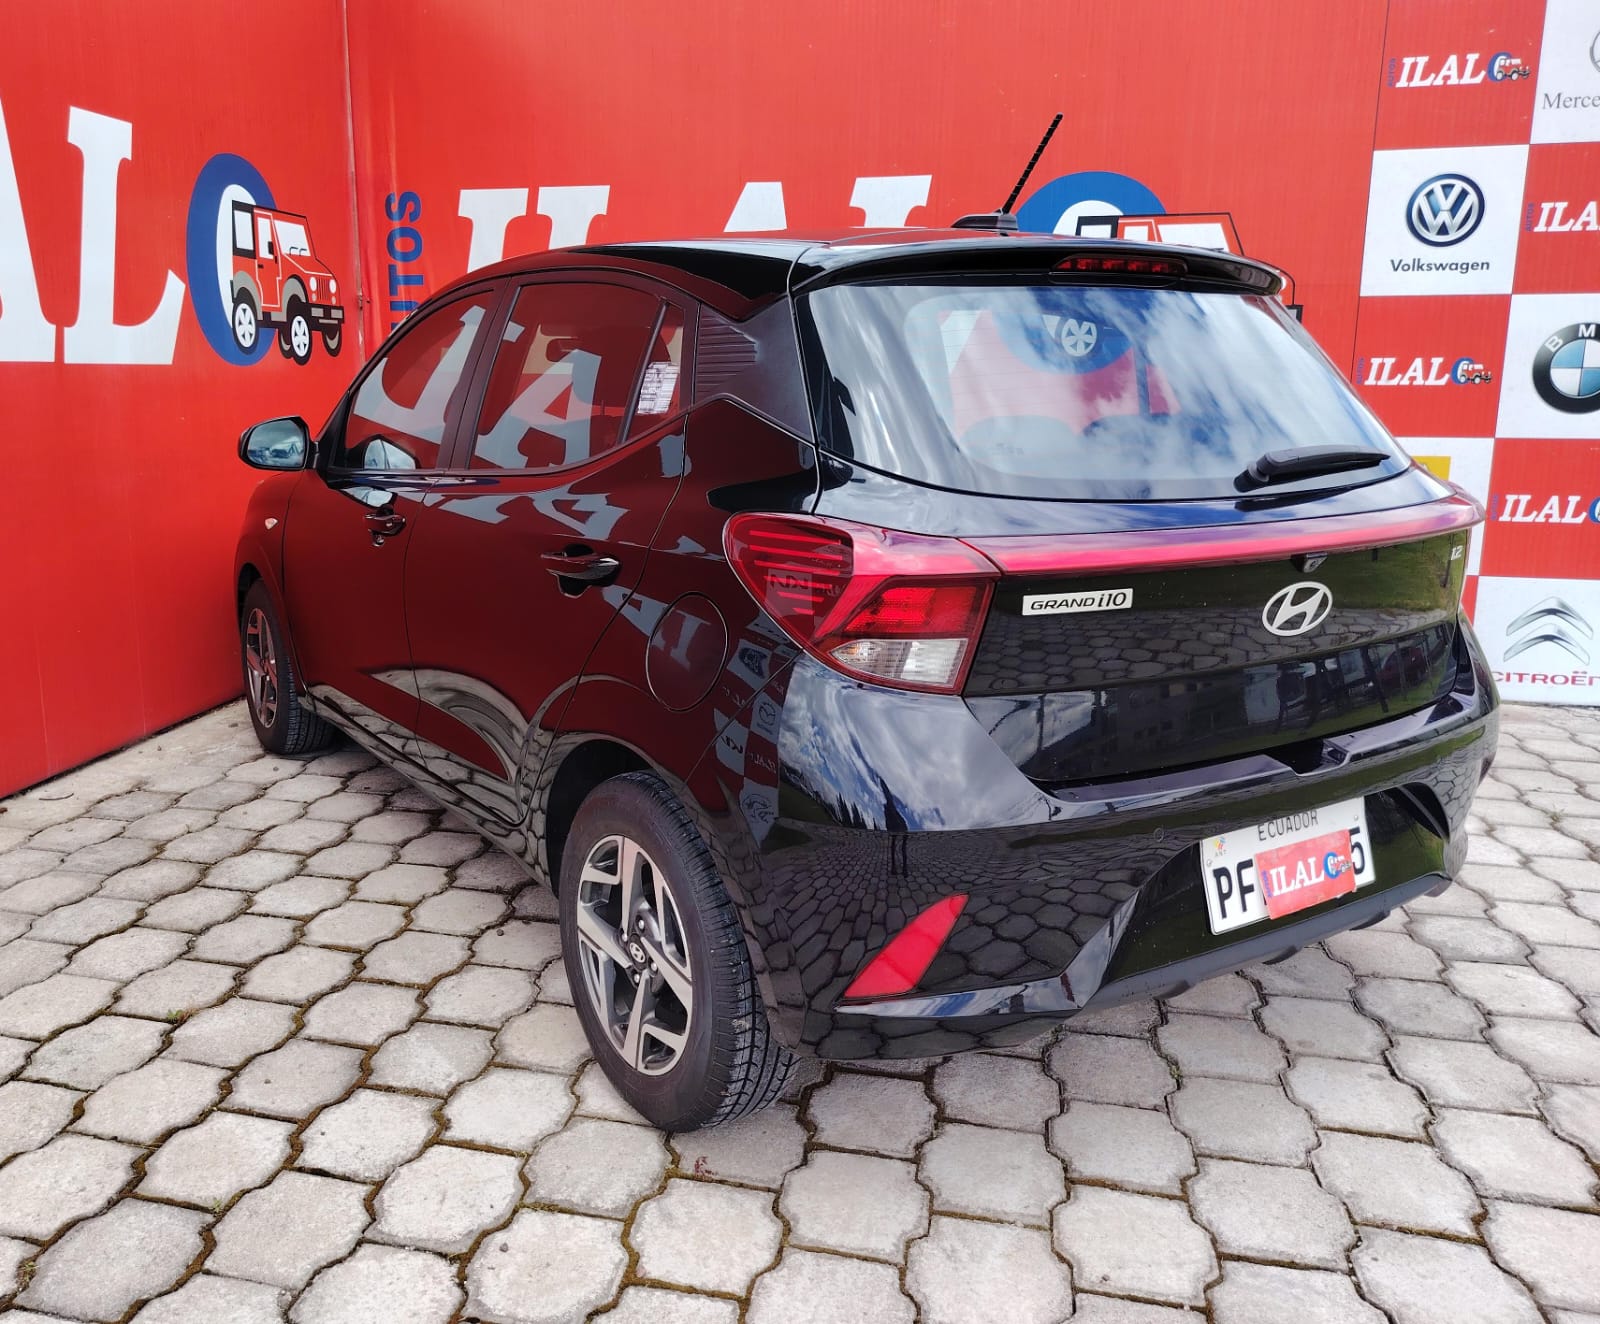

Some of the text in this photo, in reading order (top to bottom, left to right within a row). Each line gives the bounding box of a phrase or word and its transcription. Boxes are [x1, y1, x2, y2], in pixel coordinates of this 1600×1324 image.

[1533, 200, 1600, 232] ILA
[1390, 258, 1490, 275] Volkswagen
[1031, 592, 1127, 611] GRAND i10
[1257, 809, 1319, 842] ECUADOR
